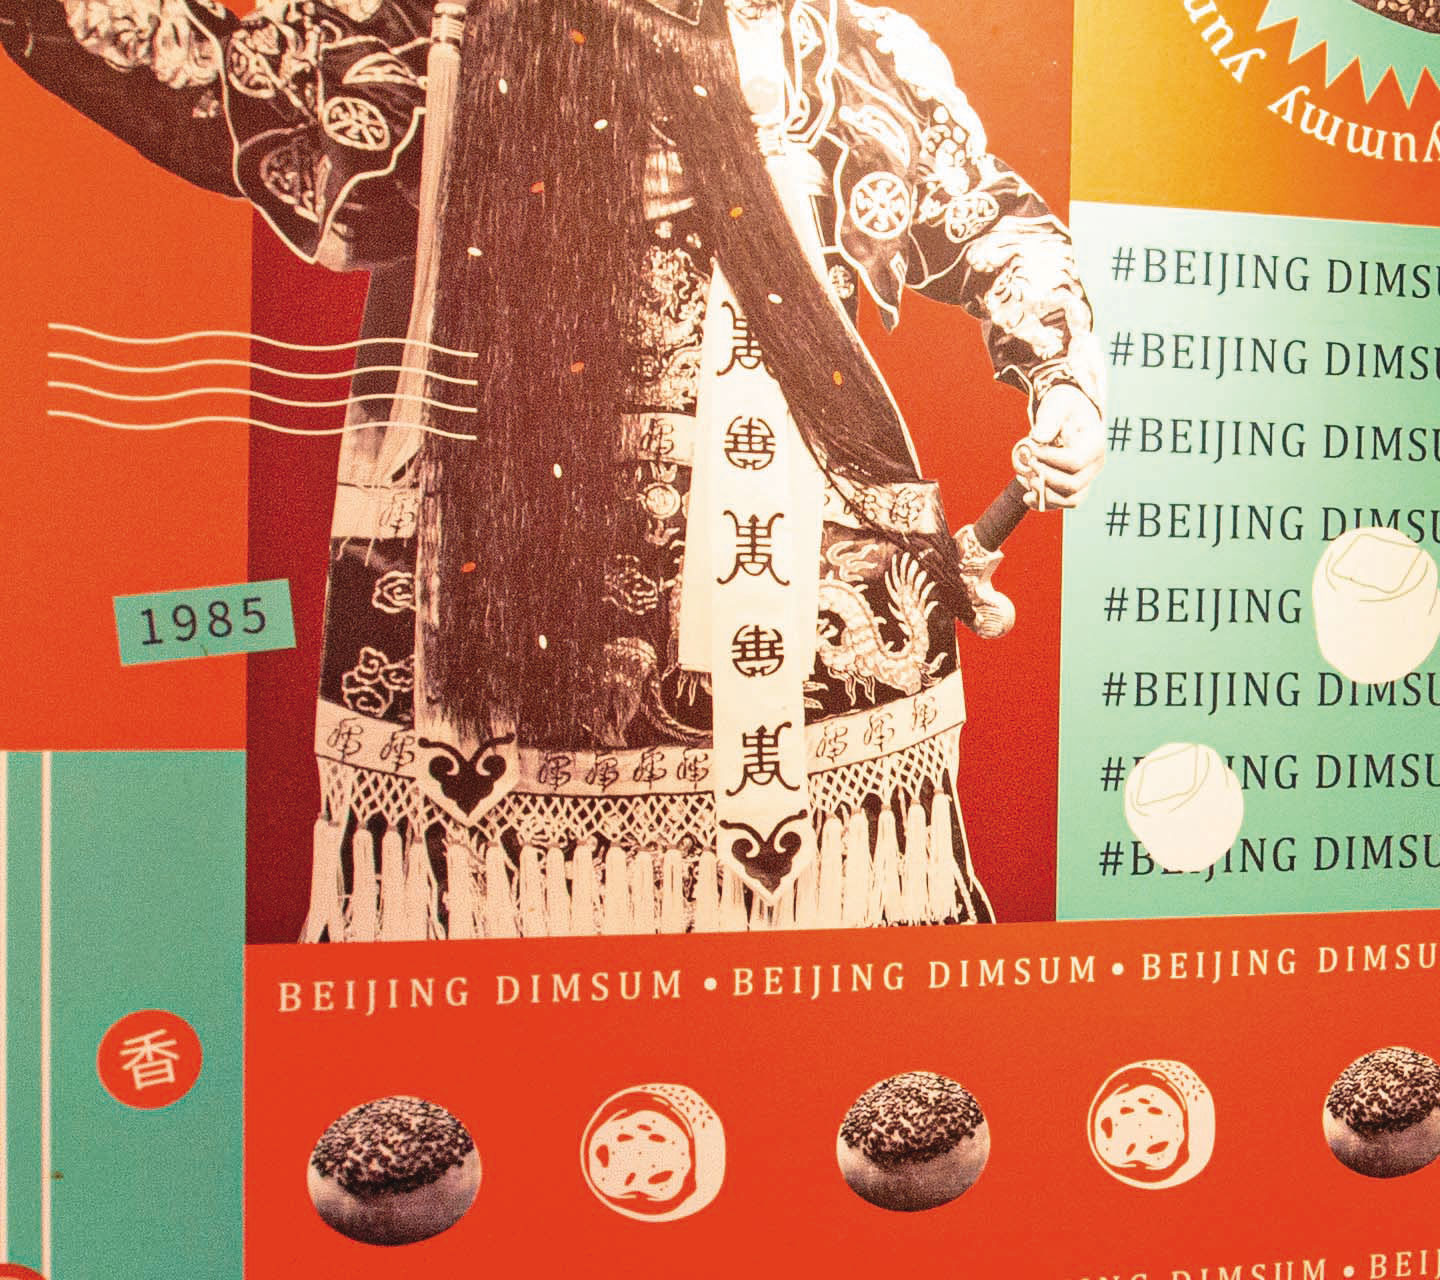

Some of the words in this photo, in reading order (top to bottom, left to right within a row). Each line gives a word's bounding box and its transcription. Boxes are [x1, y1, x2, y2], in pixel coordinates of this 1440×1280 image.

[1111, 246, 1311, 296] #BEIJING
[1108, 331, 1309, 380] #BEIJING
[1107, 416, 1307, 463] #BEIJING
[1105, 501, 1304, 548] #BEIJING
[139, 597, 270, 647] 1985
[1104, 586, 1302, 632] #BEIJING
[1102, 671, 1300, 716] #BEIJING
[277, 975, 470, 1018] BEIJING
[495, 969, 683, 1006] DIMSUM
[731, 961, 906, 1000] BEIJING
[928, 953, 1097, 990] DIMSUM
[1140, 948, 1298, 984] BEIJING
[119, 1028, 182, 1092] 香
